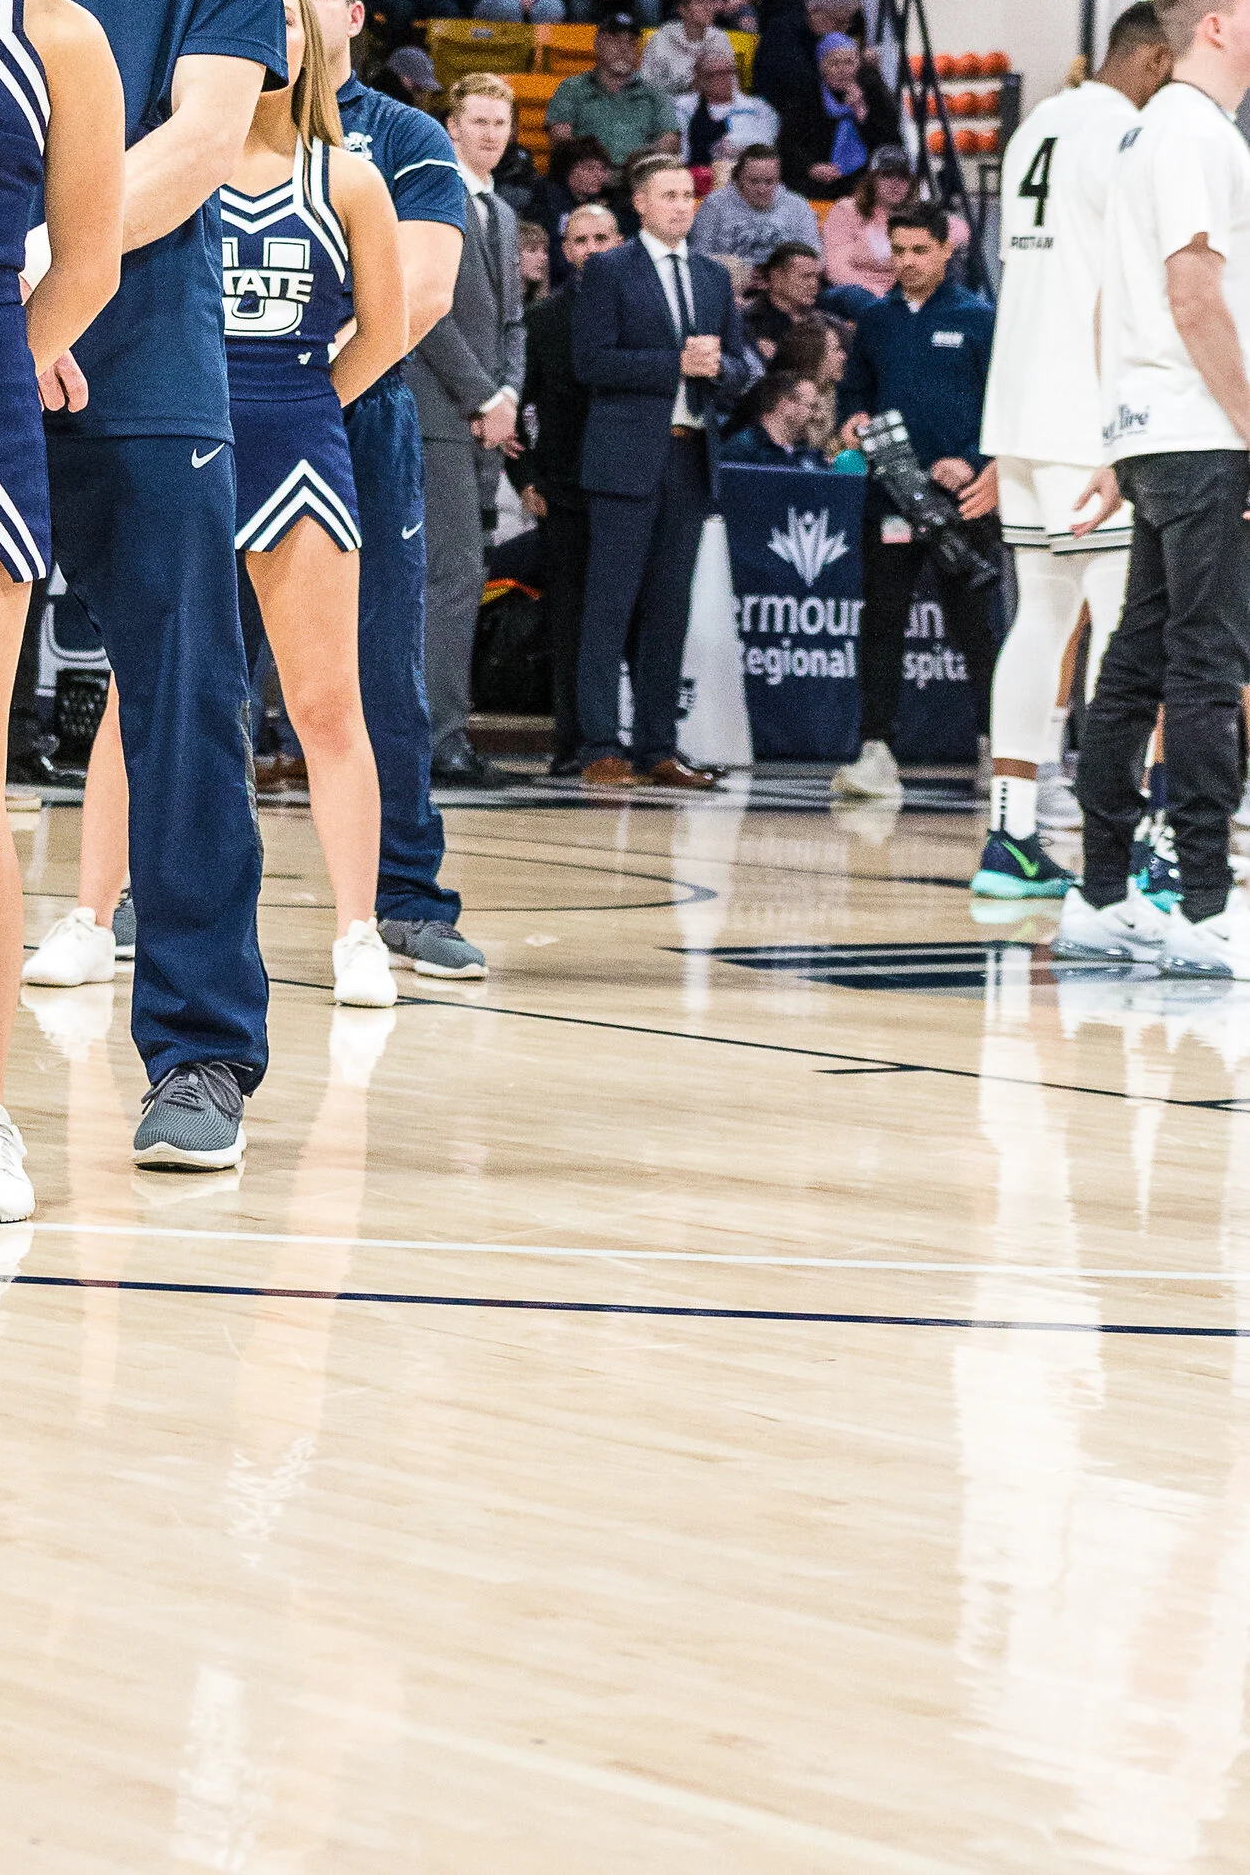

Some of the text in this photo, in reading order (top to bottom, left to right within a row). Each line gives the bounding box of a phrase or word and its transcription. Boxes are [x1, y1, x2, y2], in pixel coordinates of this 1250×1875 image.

[1017, 136, 1058, 227] 4
[222, 269, 314, 304] TATE
[744, 637, 857, 686] egional
